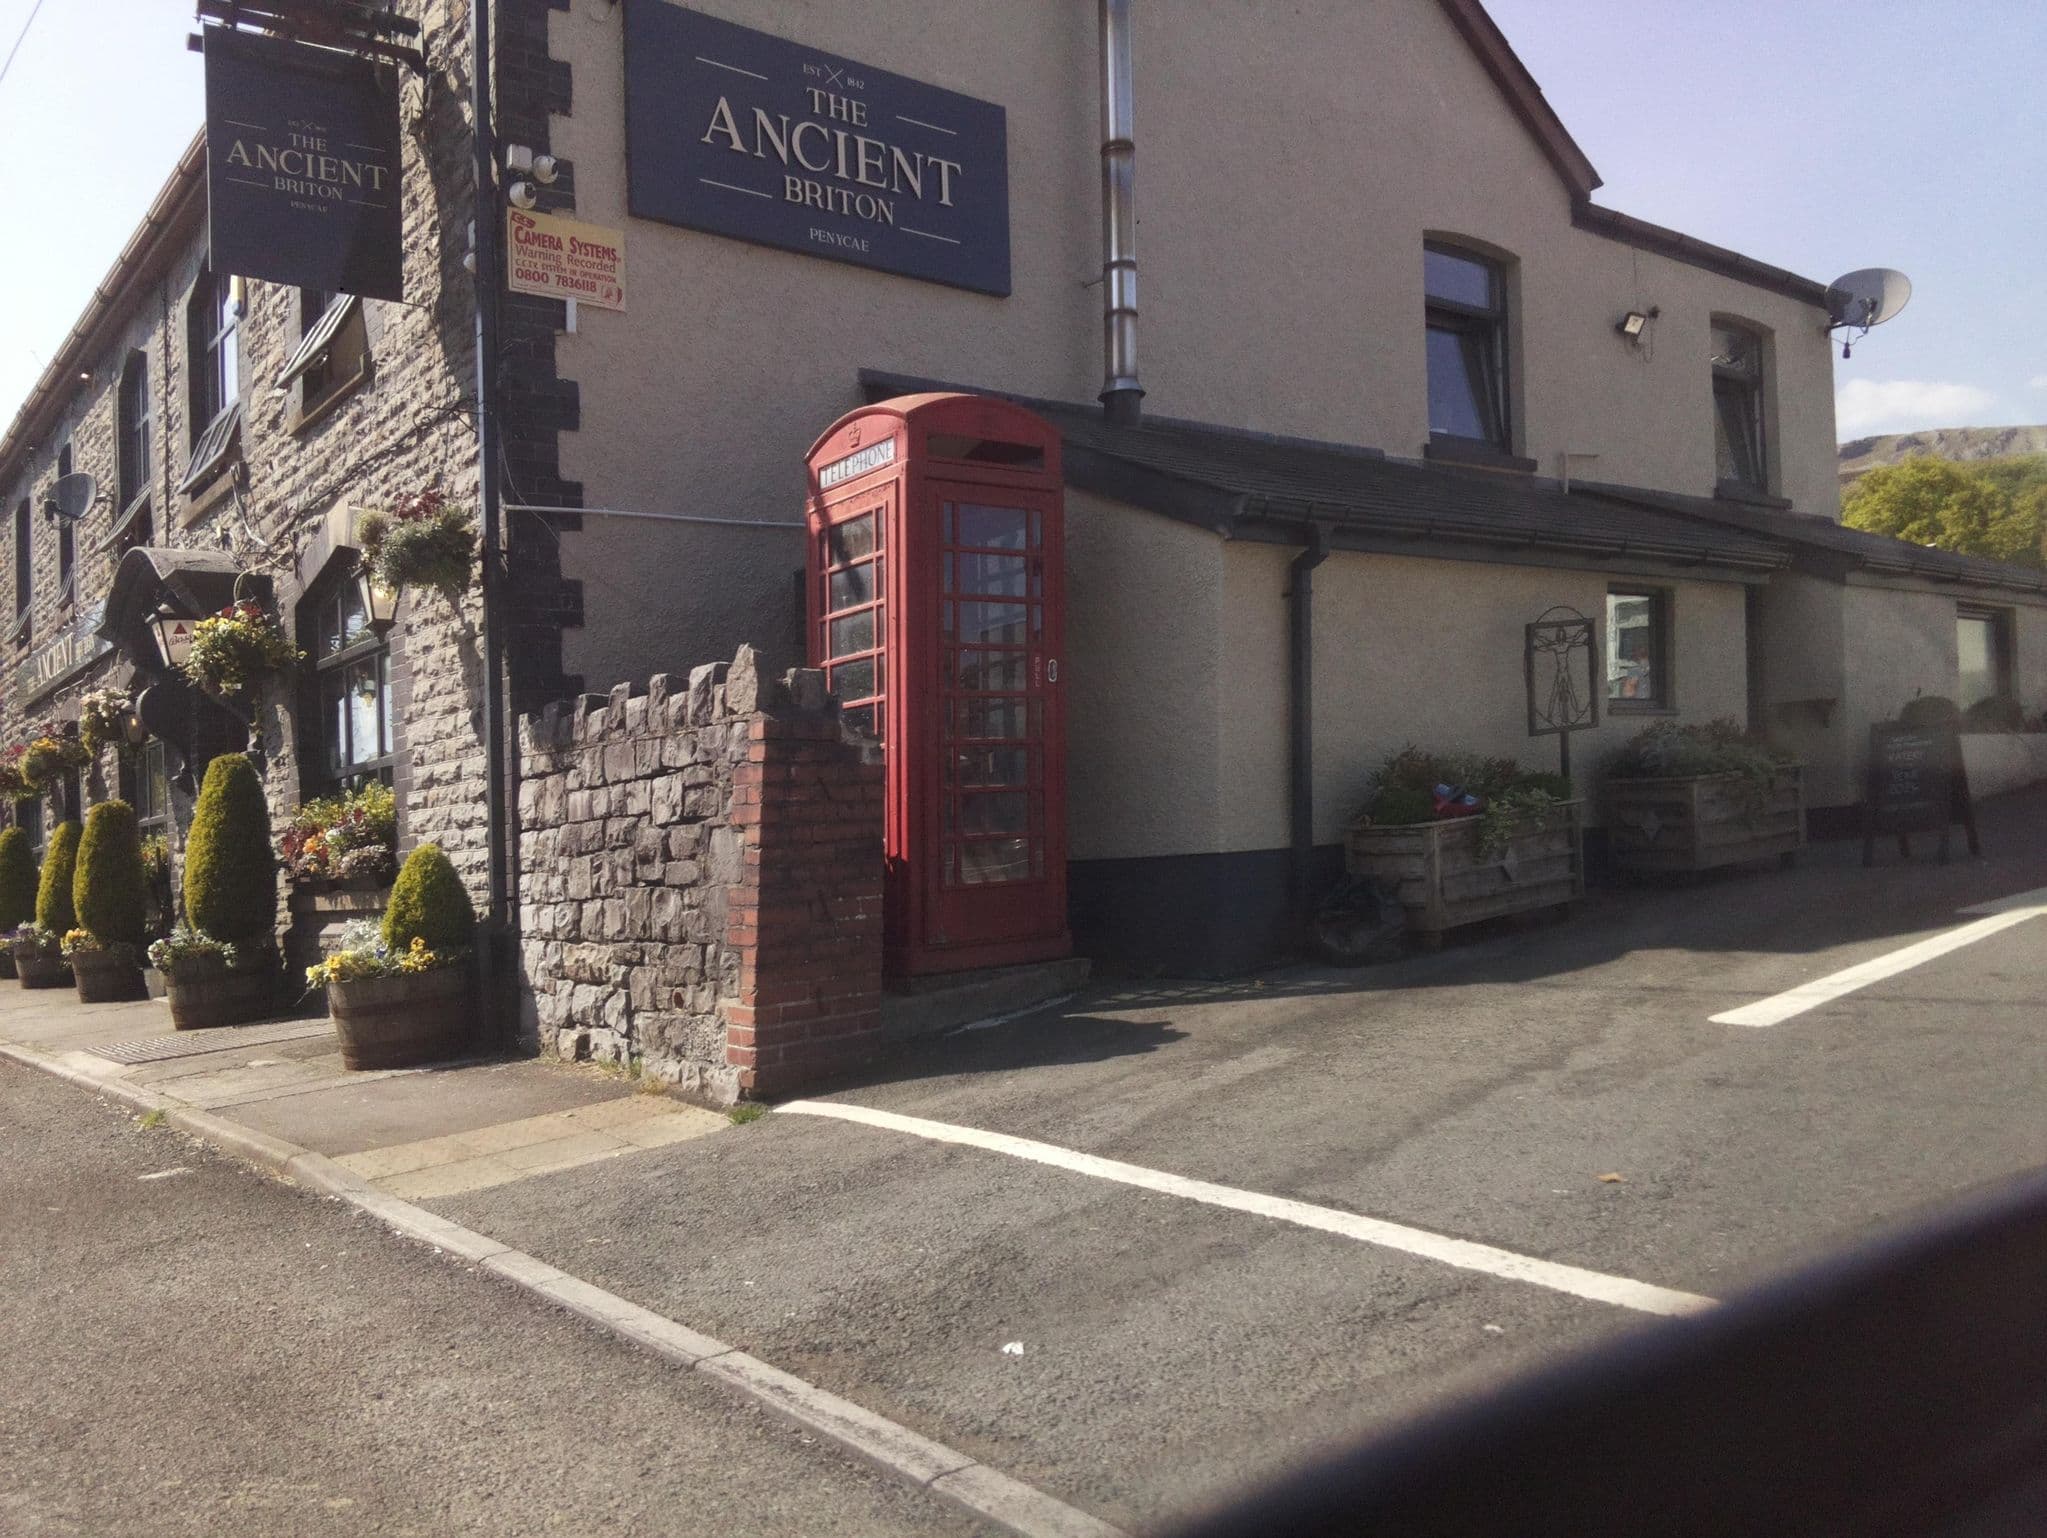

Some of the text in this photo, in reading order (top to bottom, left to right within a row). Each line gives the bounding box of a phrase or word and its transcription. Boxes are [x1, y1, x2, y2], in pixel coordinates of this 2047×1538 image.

[806, 87, 868, 128] THE
[287, 132, 328, 152] THE
[701, 96, 962, 207] ANCIENT
[226, 139, 389, 190] ANCIENT
[275, 176, 343, 201] BRITON
[784, 175, 894, 226] BRITON
[514, 225, 564, 251] CAMERA
[809, 228, 870, 252] PENYCAE
[515, 244, 616, 273] Warning Recorded
[515, 268, 549, 284] 0800
[822, 444, 893, 486] TELEPHONE
